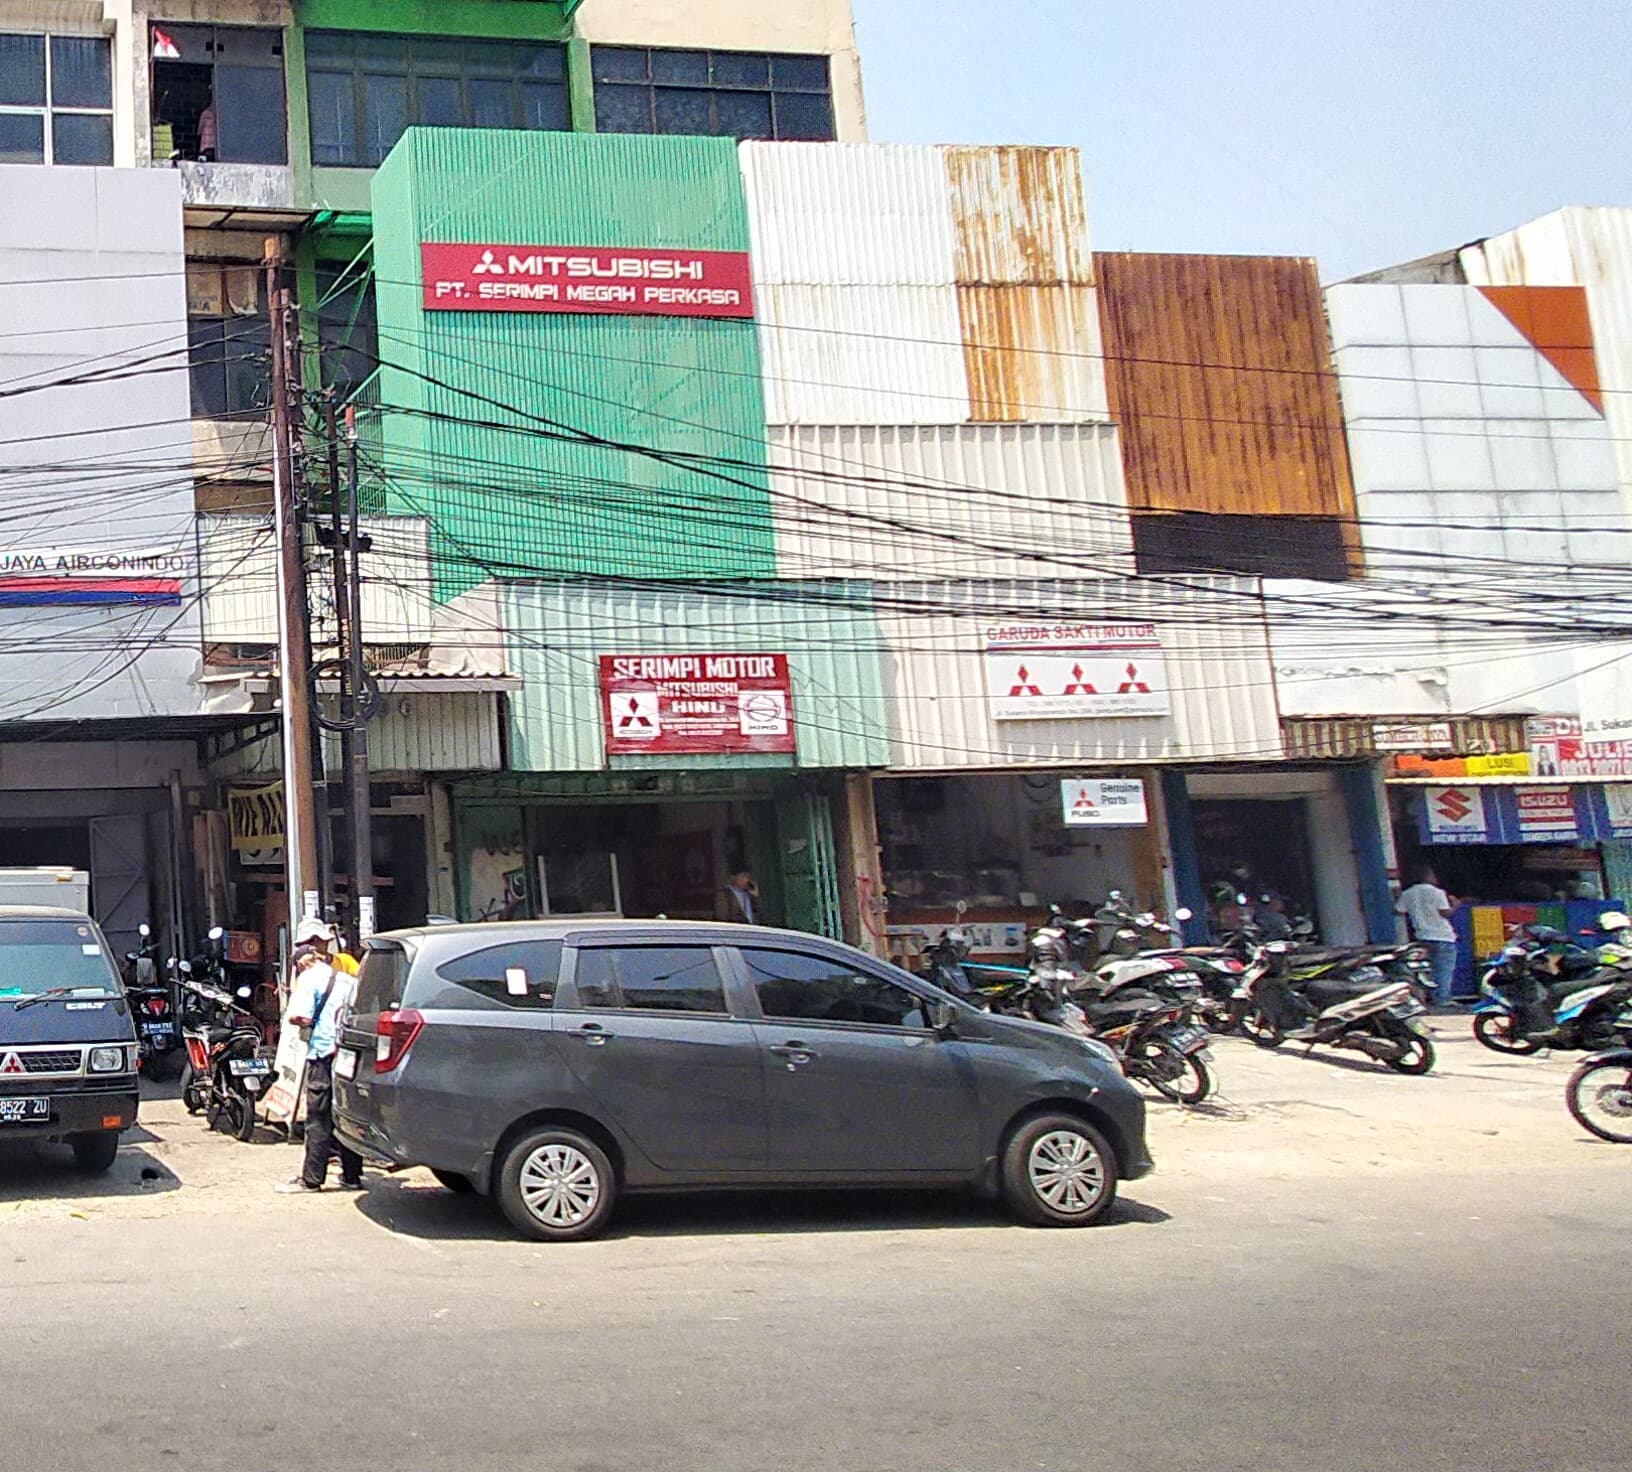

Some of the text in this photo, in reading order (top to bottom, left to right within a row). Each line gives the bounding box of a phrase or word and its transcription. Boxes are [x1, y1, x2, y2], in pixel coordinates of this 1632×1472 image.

[508, 255, 704, 281] MITSUBISHI
[435, 281, 740, 306] PT. SERIMPI MEGAH PERKASA
[986, 624, 1158, 641] GARUDA SAKTI MOTOR
[612, 656, 776, 680] SERIMPI MOTOR
[656, 681, 739, 698] MITSUBISHI
[0, 1100, 27, 1114] 8522
